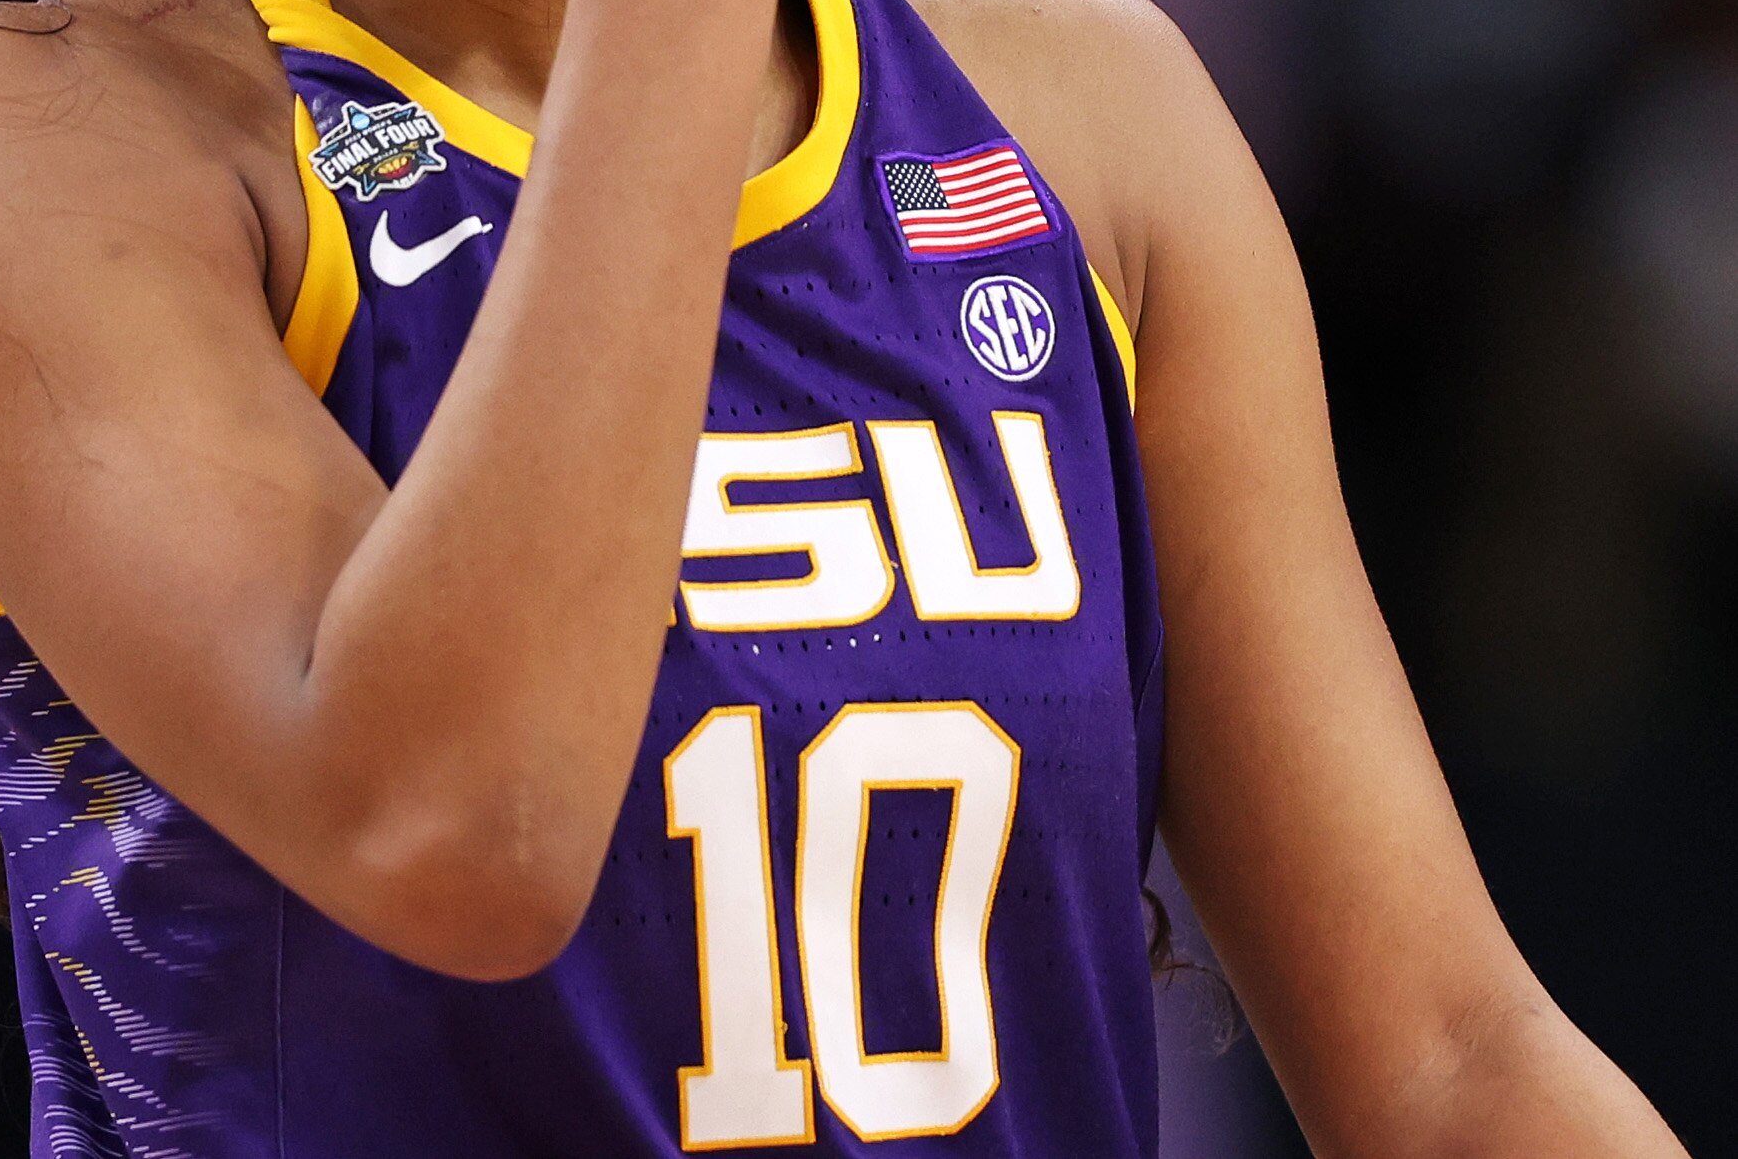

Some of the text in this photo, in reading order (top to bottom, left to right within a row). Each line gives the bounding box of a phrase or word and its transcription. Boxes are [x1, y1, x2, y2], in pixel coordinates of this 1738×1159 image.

[321, 138, 379, 181] FINAL
[374, 117, 436, 149] FOUR
[968, 284, 1047, 372] SEC
[668, 409, 1082, 633] SU
[662, 700, 1022, 1153] 10
